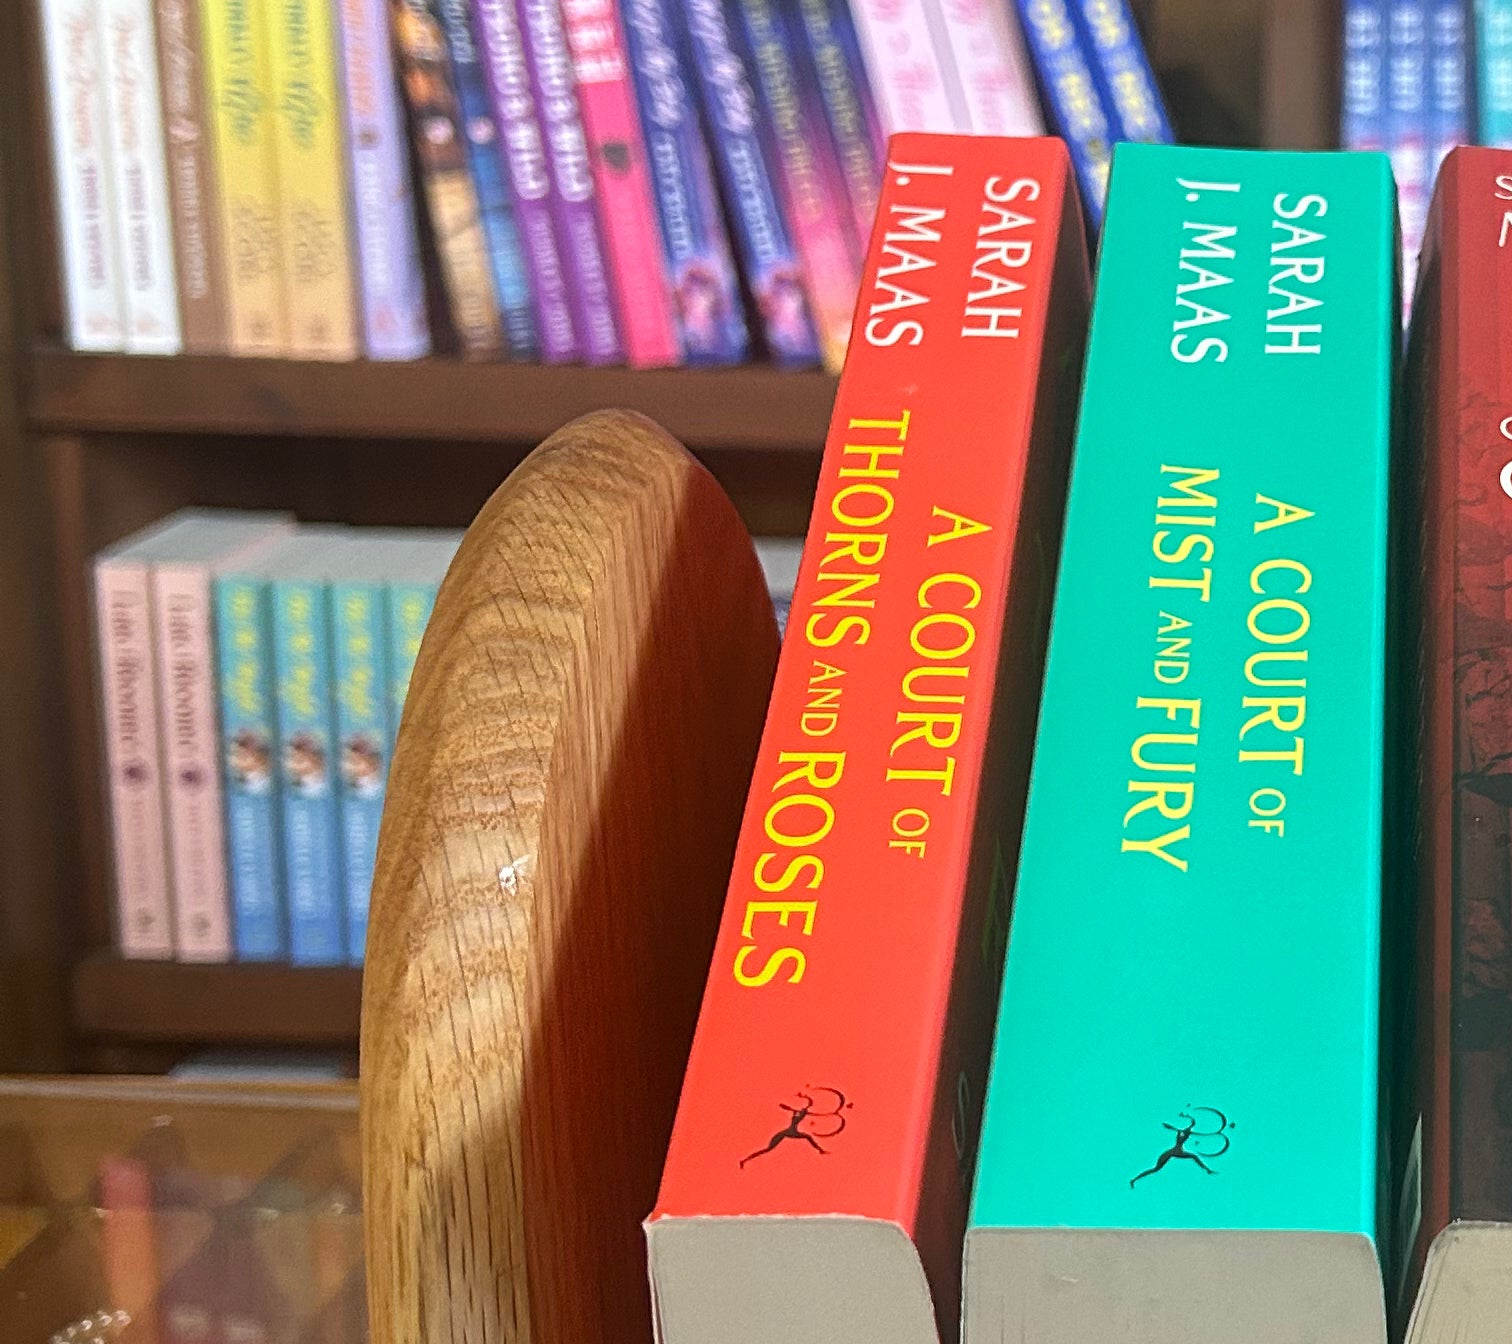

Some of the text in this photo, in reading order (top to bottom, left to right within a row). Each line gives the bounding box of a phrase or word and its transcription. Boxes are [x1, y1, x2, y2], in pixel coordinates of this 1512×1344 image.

[863, 160, 954, 348] J. MAAS
[961, 176, 1042, 339] SARAH
[1171, 178, 1241, 364] J. MAAS
[1265, 193, 1327, 354] SARAH
[733, 409, 911, 987] THORNS AND ROSES
[886, 505, 993, 859] A COURT OF
[1121, 464, 1220, 873] MIST AND FURY
[1238, 493, 1315, 837] A COURT OF
